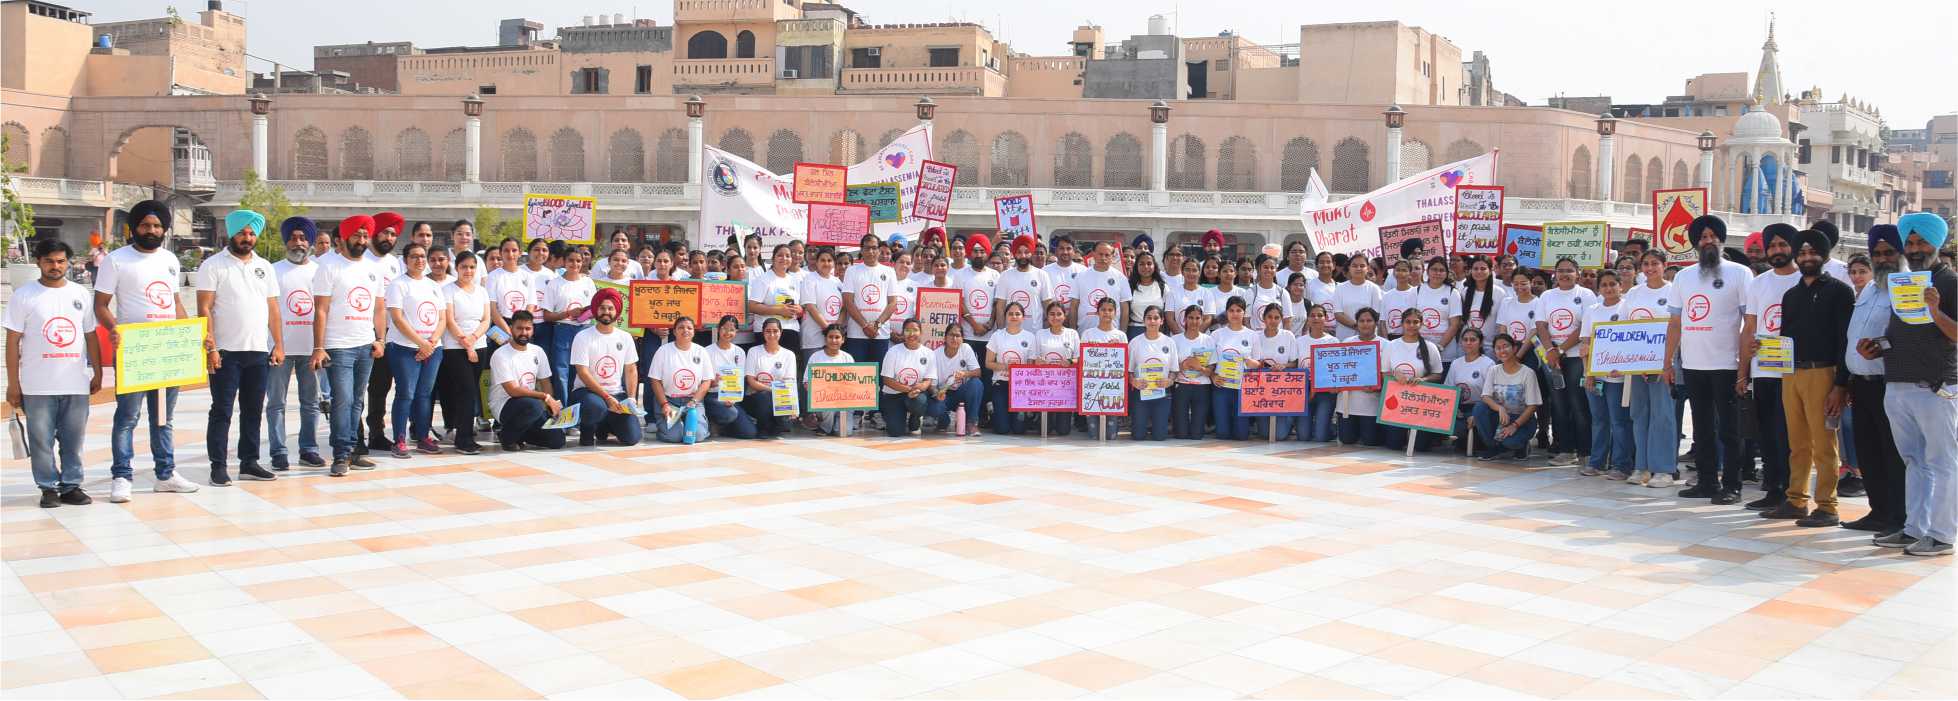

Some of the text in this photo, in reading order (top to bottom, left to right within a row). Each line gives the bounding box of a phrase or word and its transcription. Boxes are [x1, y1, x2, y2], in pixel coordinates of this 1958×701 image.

[1416, 195, 1455, 209] THALASS
[1313, 206, 1351, 225] Mukt
[751, 226, 777, 237] ALK
[1314, 223, 1358, 250] Bharat
[1595, 328, 1613, 339] HELP
[1610, 331, 1647, 342] CHILDREN
[812, 369, 826, 379] HELP
[825, 372, 857, 382] CHILDREN
